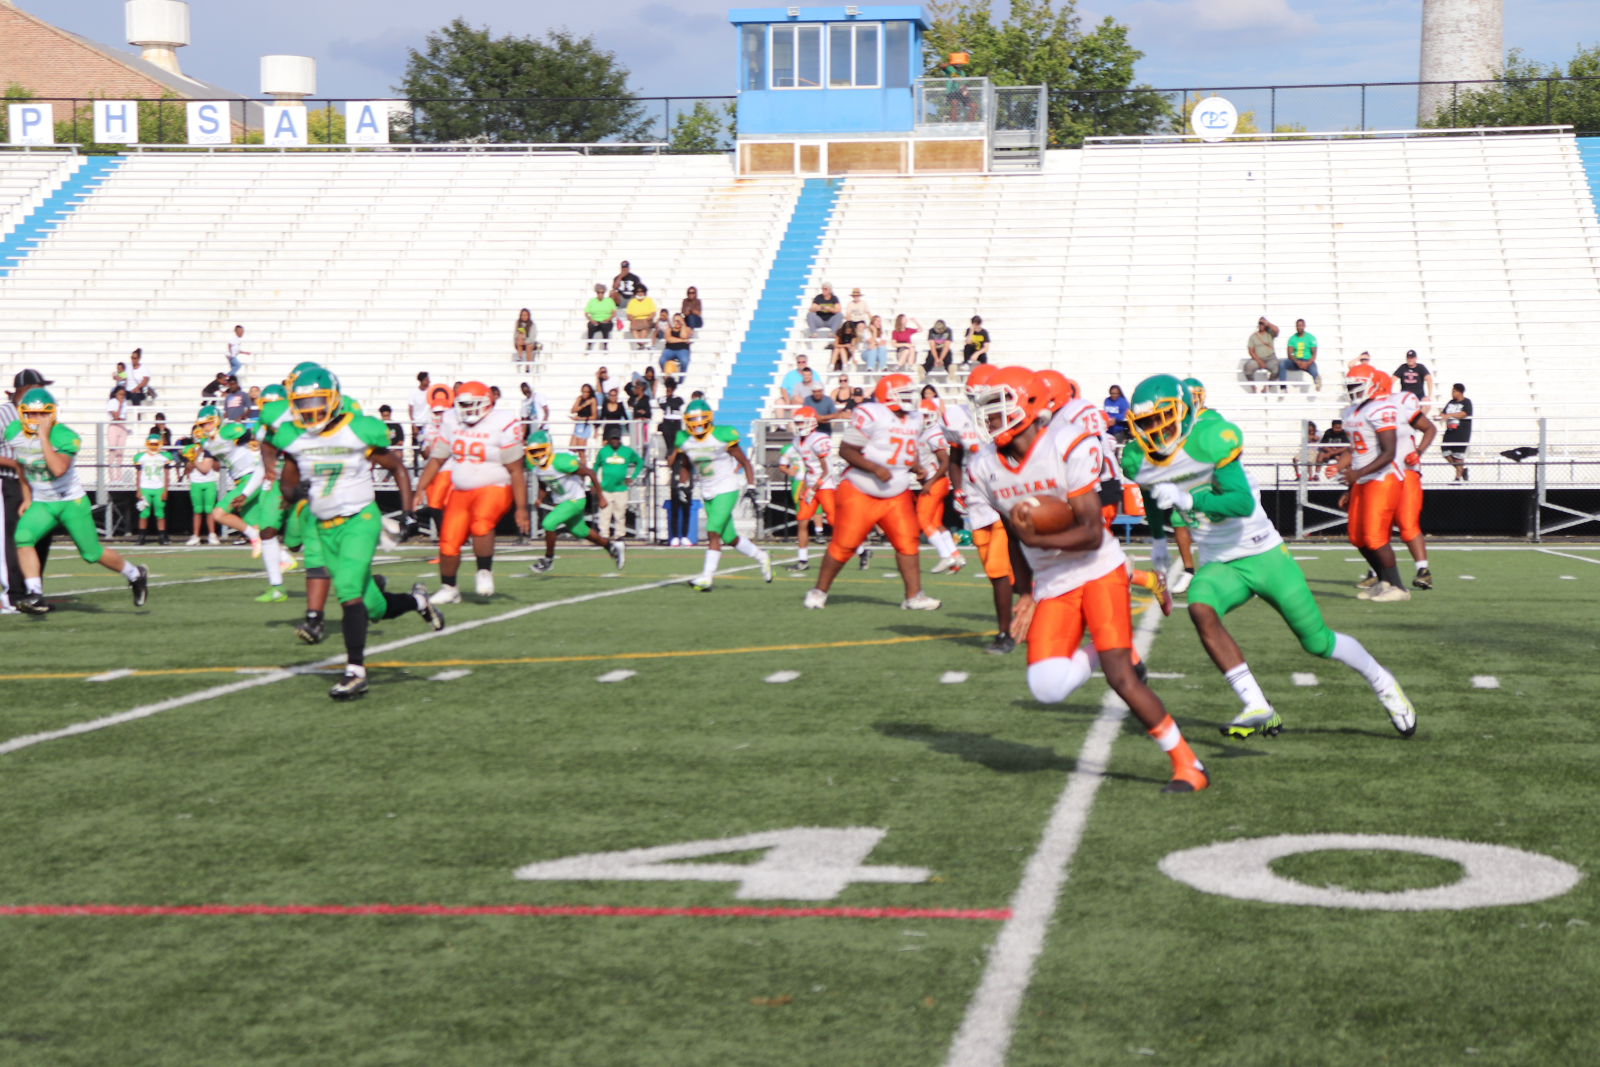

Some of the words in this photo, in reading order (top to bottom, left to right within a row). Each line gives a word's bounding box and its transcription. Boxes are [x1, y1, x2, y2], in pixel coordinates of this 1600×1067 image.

[21, 107, 42, 137] P
[105, 104, 127, 133] H
[198, 104, 220, 135] S
[274, 109, 298, 139] A
[355, 104, 380, 134] A
[195, 135, 225, 143] SCHOOL
[452, 439, 486, 464] 99
[886, 436, 917, 467] 79
[1089, 447, 1101, 474] 3
[313, 461, 345, 498] 7
